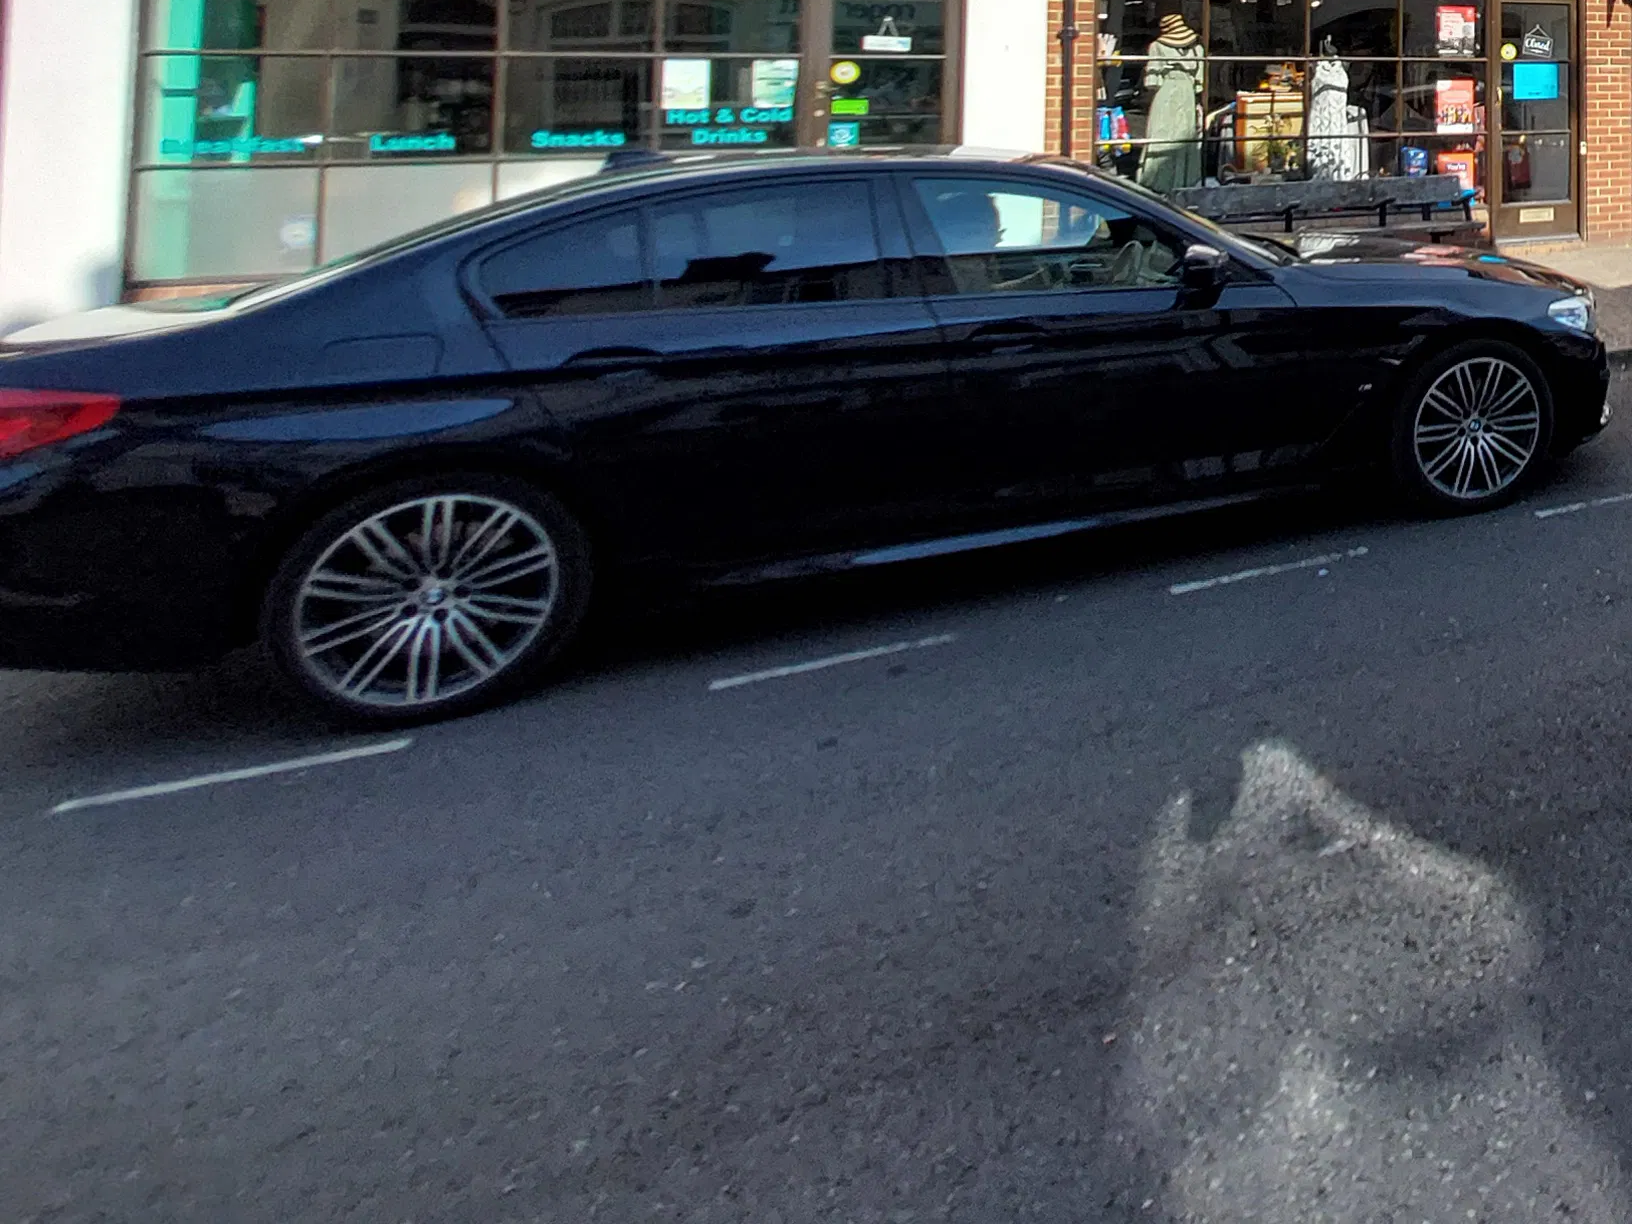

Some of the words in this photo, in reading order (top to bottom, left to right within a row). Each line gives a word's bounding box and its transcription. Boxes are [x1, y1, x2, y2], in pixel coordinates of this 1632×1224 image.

[1525, 37, 1550, 51] Closed
[667, 109, 709, 124] Hot
[715, 108, 734, 123] &
[740, 107, 793, 122] Cold
[369, 133, 456, 152] Lunch
[531, 130, 626, 147] Snacks
[692, 128, 768, 144] Drinks
